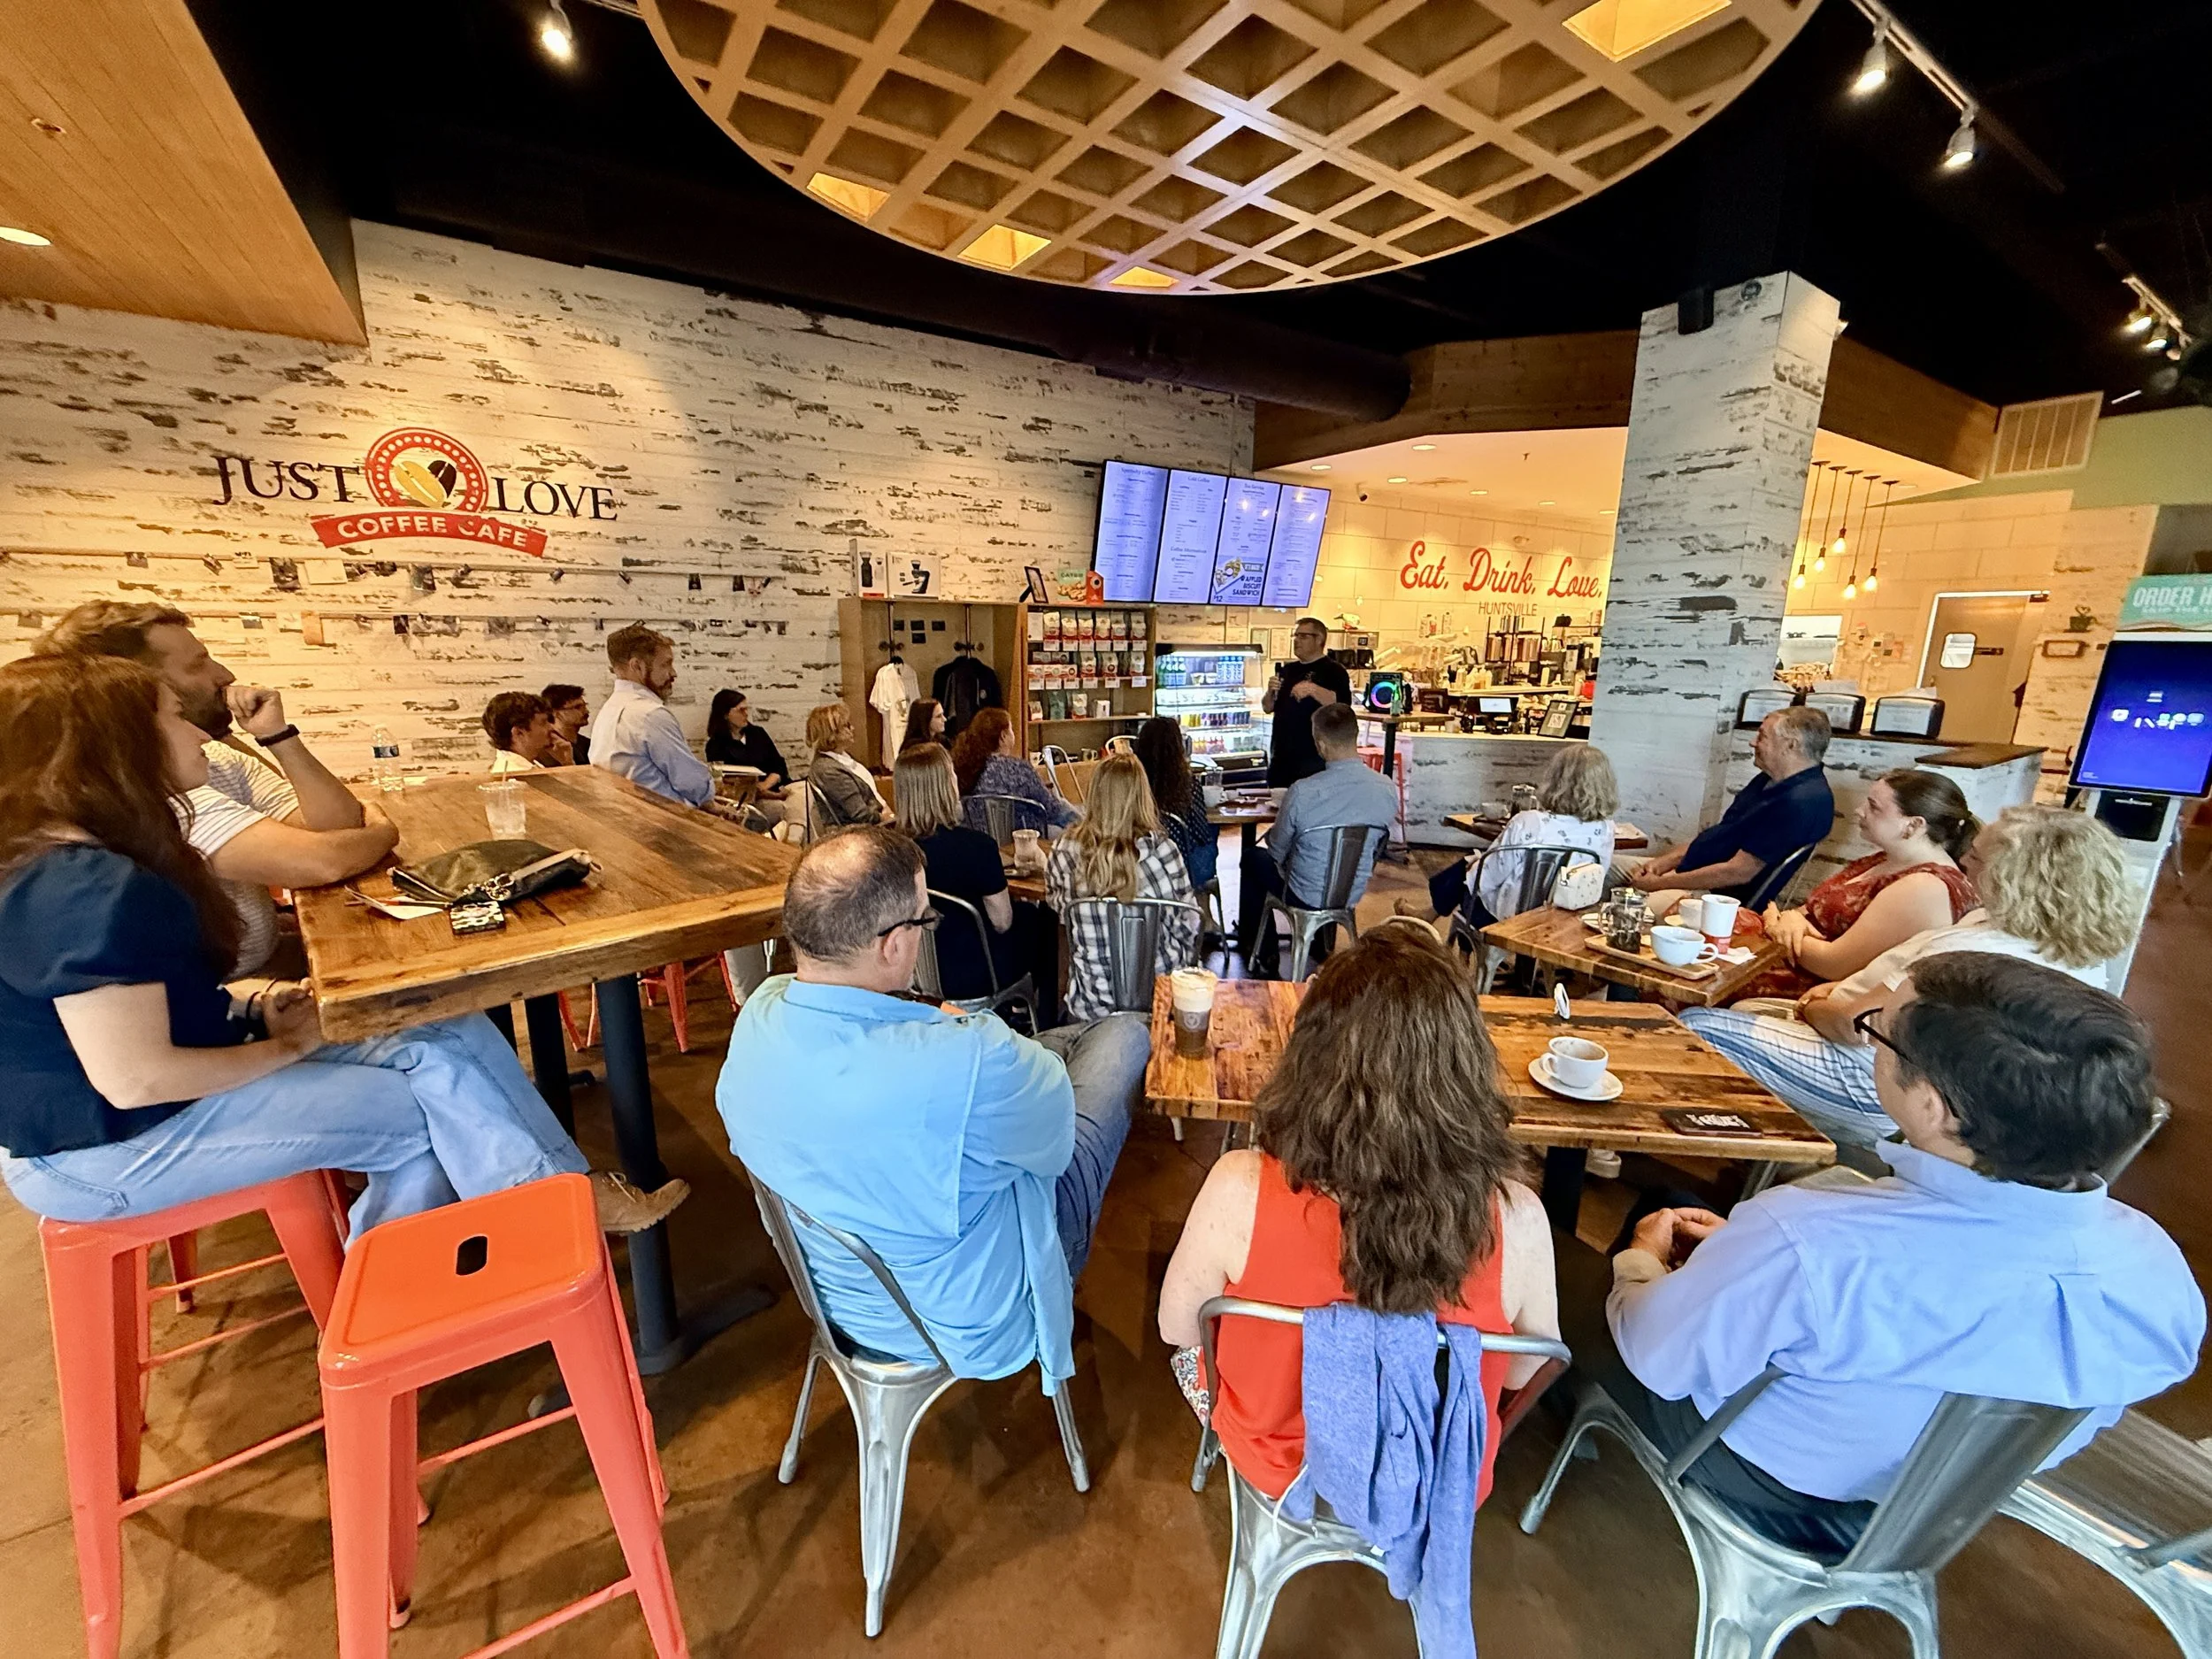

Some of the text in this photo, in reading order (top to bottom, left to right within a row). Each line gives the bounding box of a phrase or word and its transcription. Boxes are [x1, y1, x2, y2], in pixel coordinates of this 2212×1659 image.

[211, 455, 618, 521] JUST LOVE
[337, 516, 529, 548] COFFEE CAFE
[1400, 540, 1449, 589] Eat,
[1463, 547, 1536, 595] Drink,
[1478, 601, 1538, 617] HUNTSVILLE
[2132, 586, 2194, 608] ORDER
